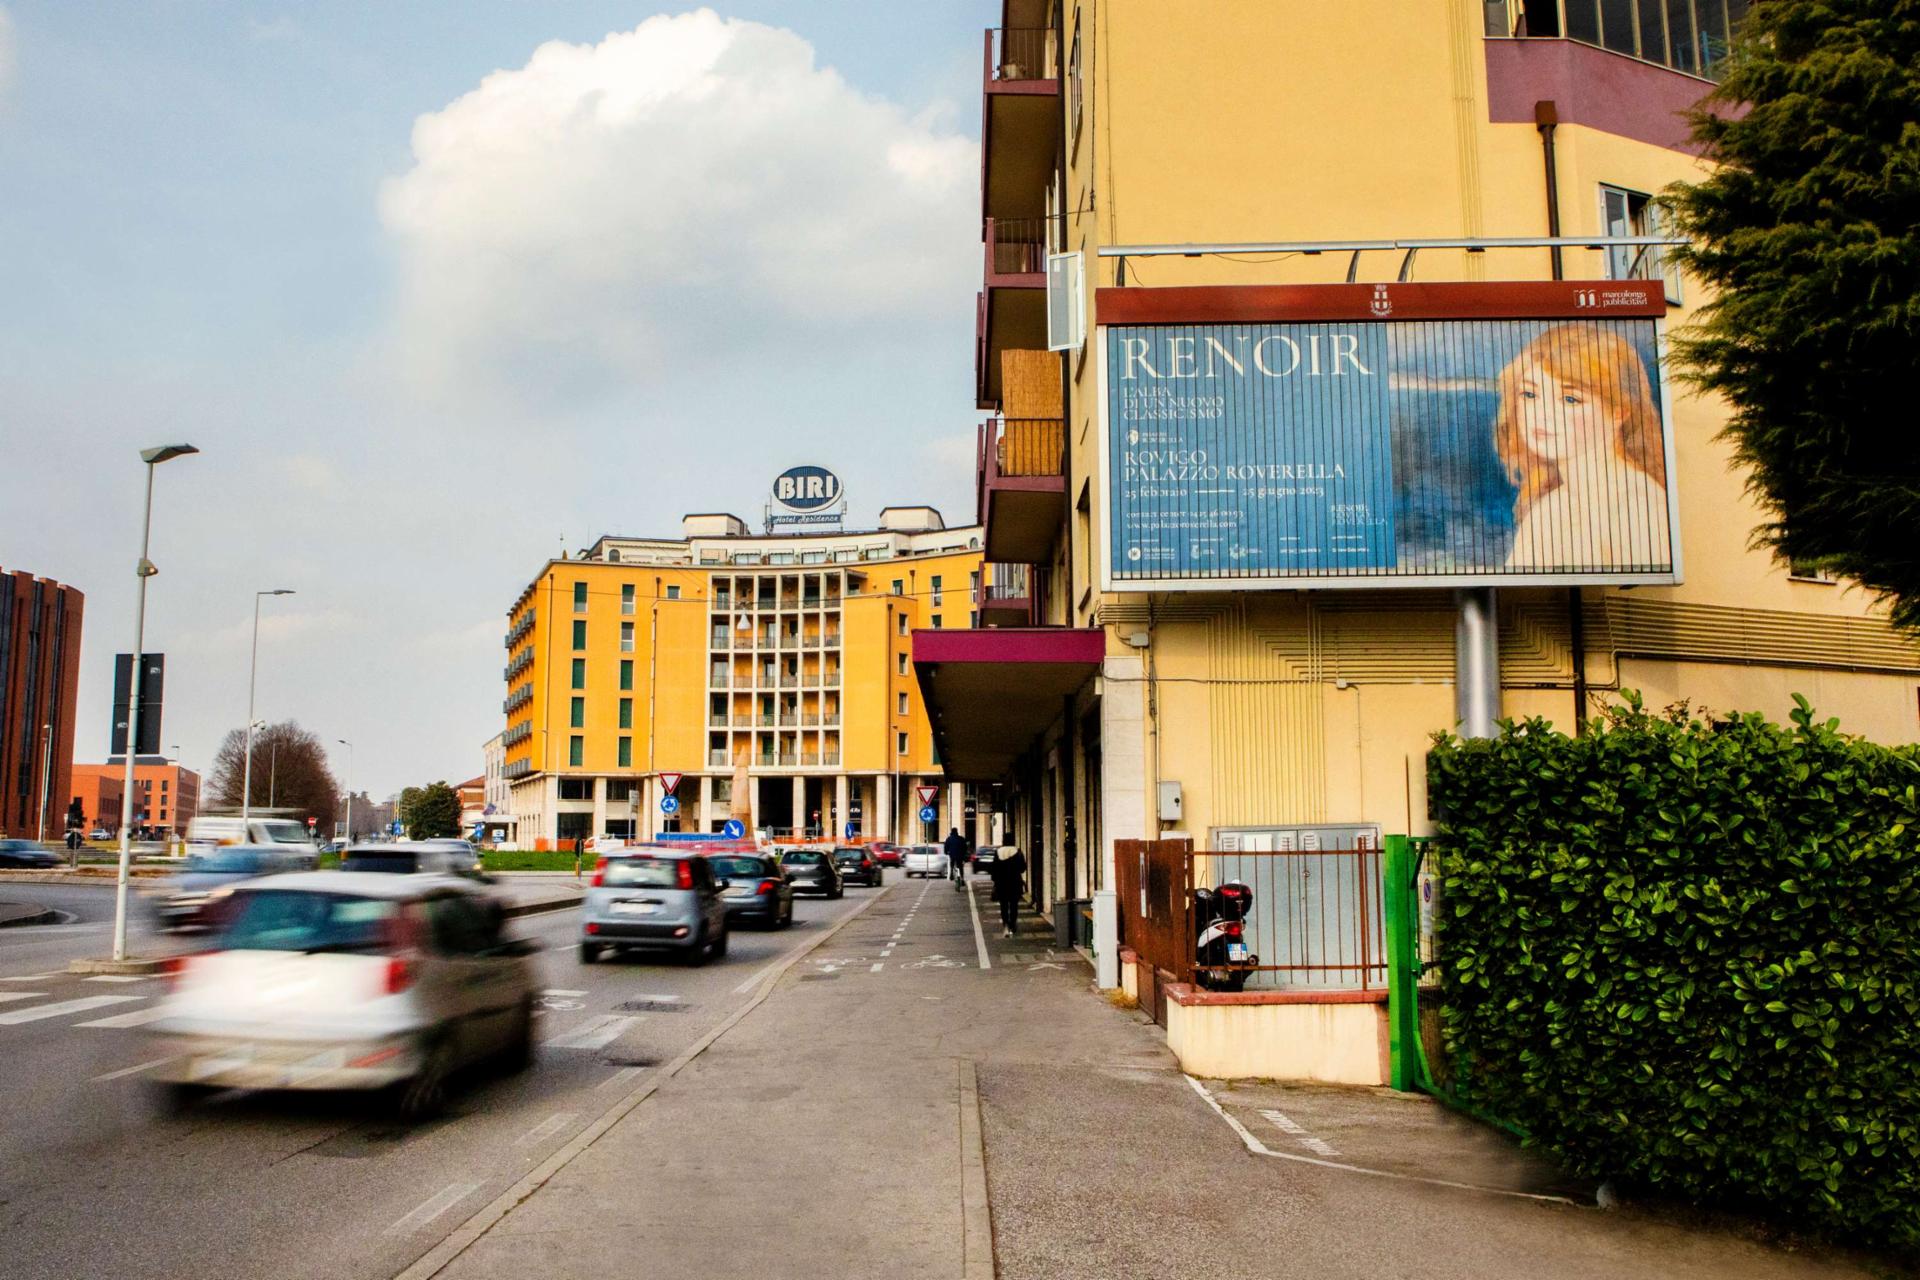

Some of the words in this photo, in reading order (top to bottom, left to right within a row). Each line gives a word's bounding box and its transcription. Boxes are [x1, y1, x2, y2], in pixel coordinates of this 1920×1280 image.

[1120, 334, 1374, 379] RENOIR
[1168, 396, 1224, 408] NUOVO
[1124, 450, 1208, 465] ROVIGO
[1124, 466, 1219, 481] PALAZZO
[1226, 463, 1346, 479] ROVERELLA
[778, 475, 834, 500] BIRI
